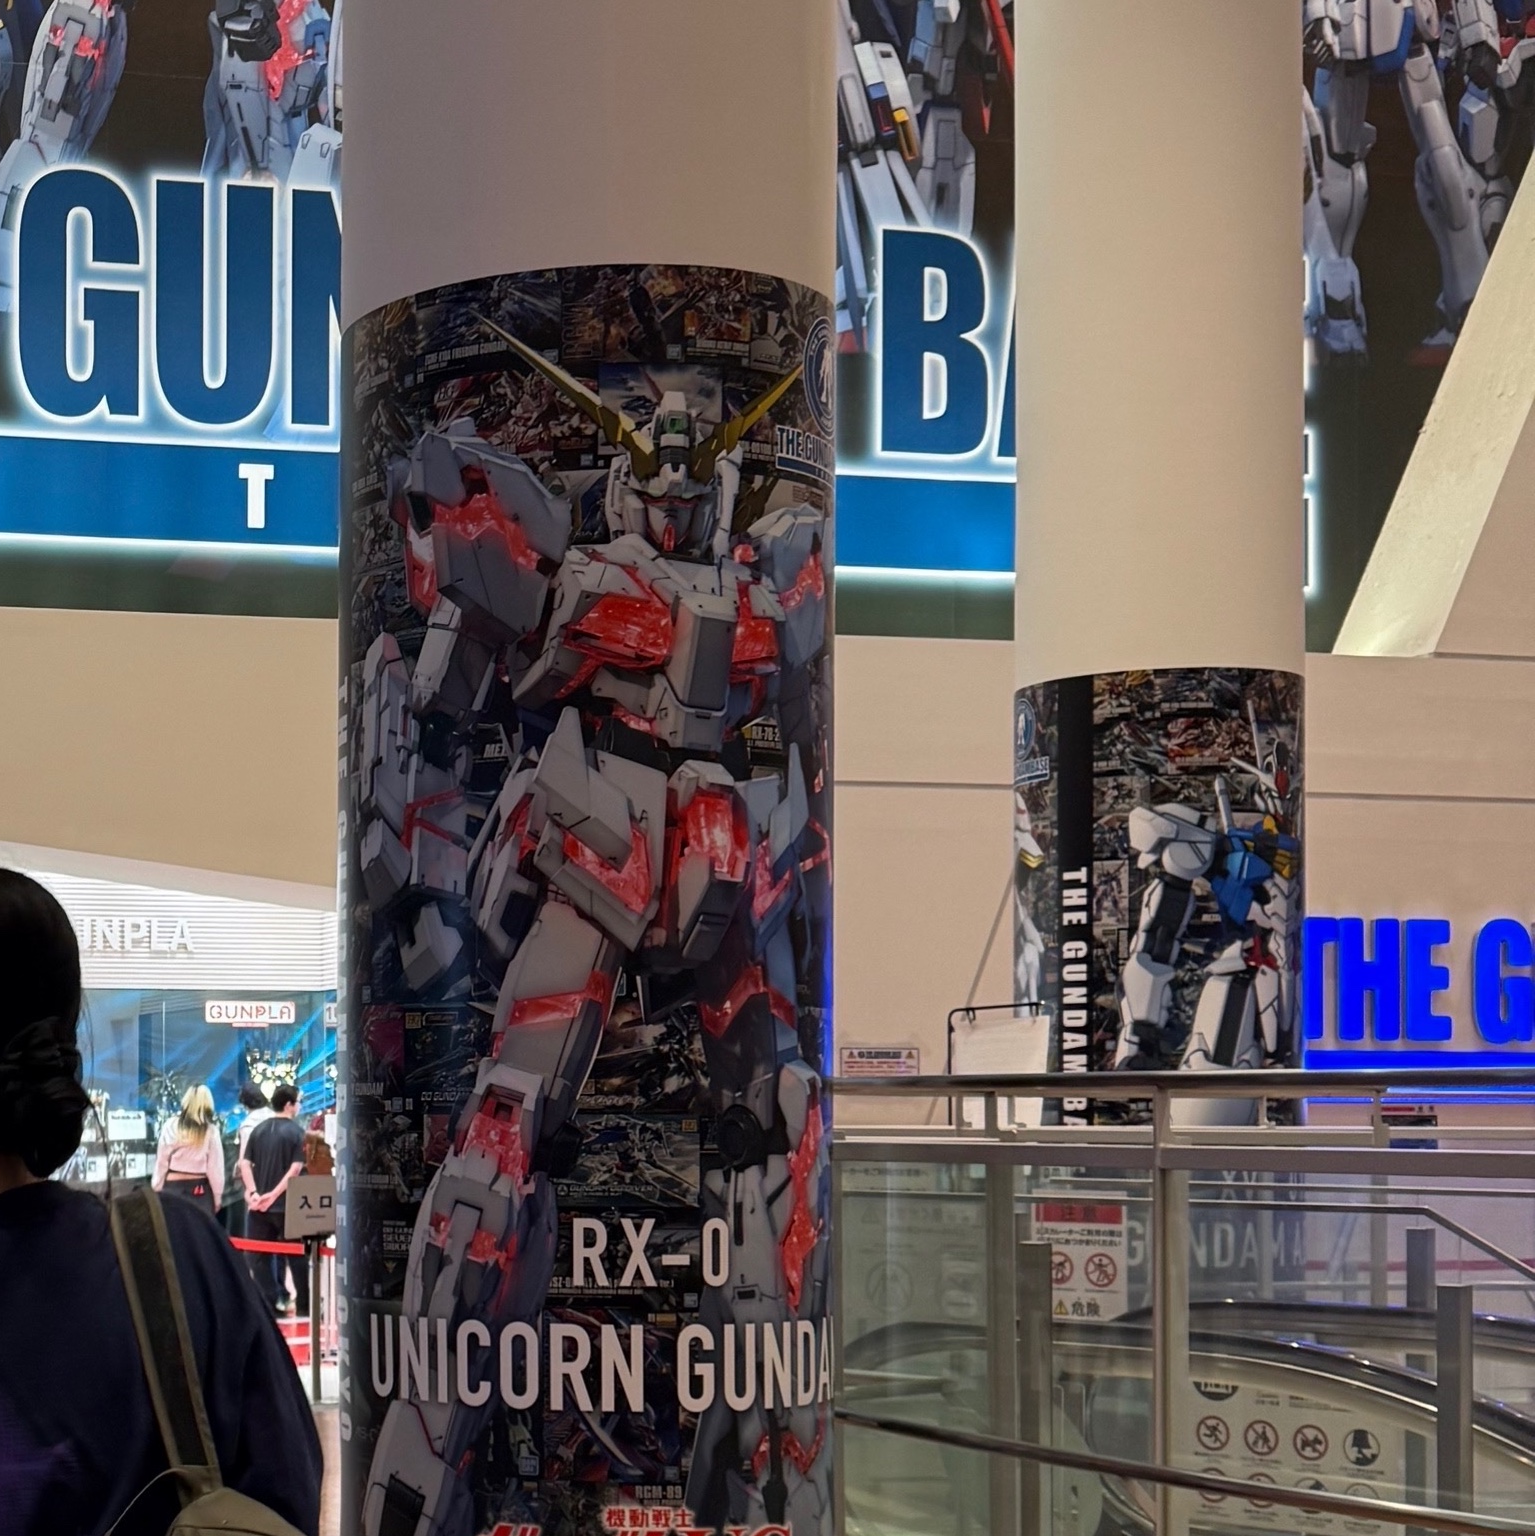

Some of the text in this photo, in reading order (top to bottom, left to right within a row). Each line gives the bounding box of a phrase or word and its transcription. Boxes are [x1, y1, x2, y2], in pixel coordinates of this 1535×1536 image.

[880, 227, 1015, 458] B
[1062, 866, 1088, 926] THE
[1062, 940, 1088, 1073] GUNDAM
[1304, 917, 1535, 1044] THE G
[209, 1004, 292, 1020] GUNPLA
[299, 1195, 332, 1210] 入口
[572, 1217, 730, 1288] RX-0
[1125, 1218, 1286, 1269] GNDAM
[1071, 1301, 1101, 1318] 危険
[370, 1312, 835, 1413] UNICORN GUNDA
[606, 1507, 694, 1528] 機動戦士
